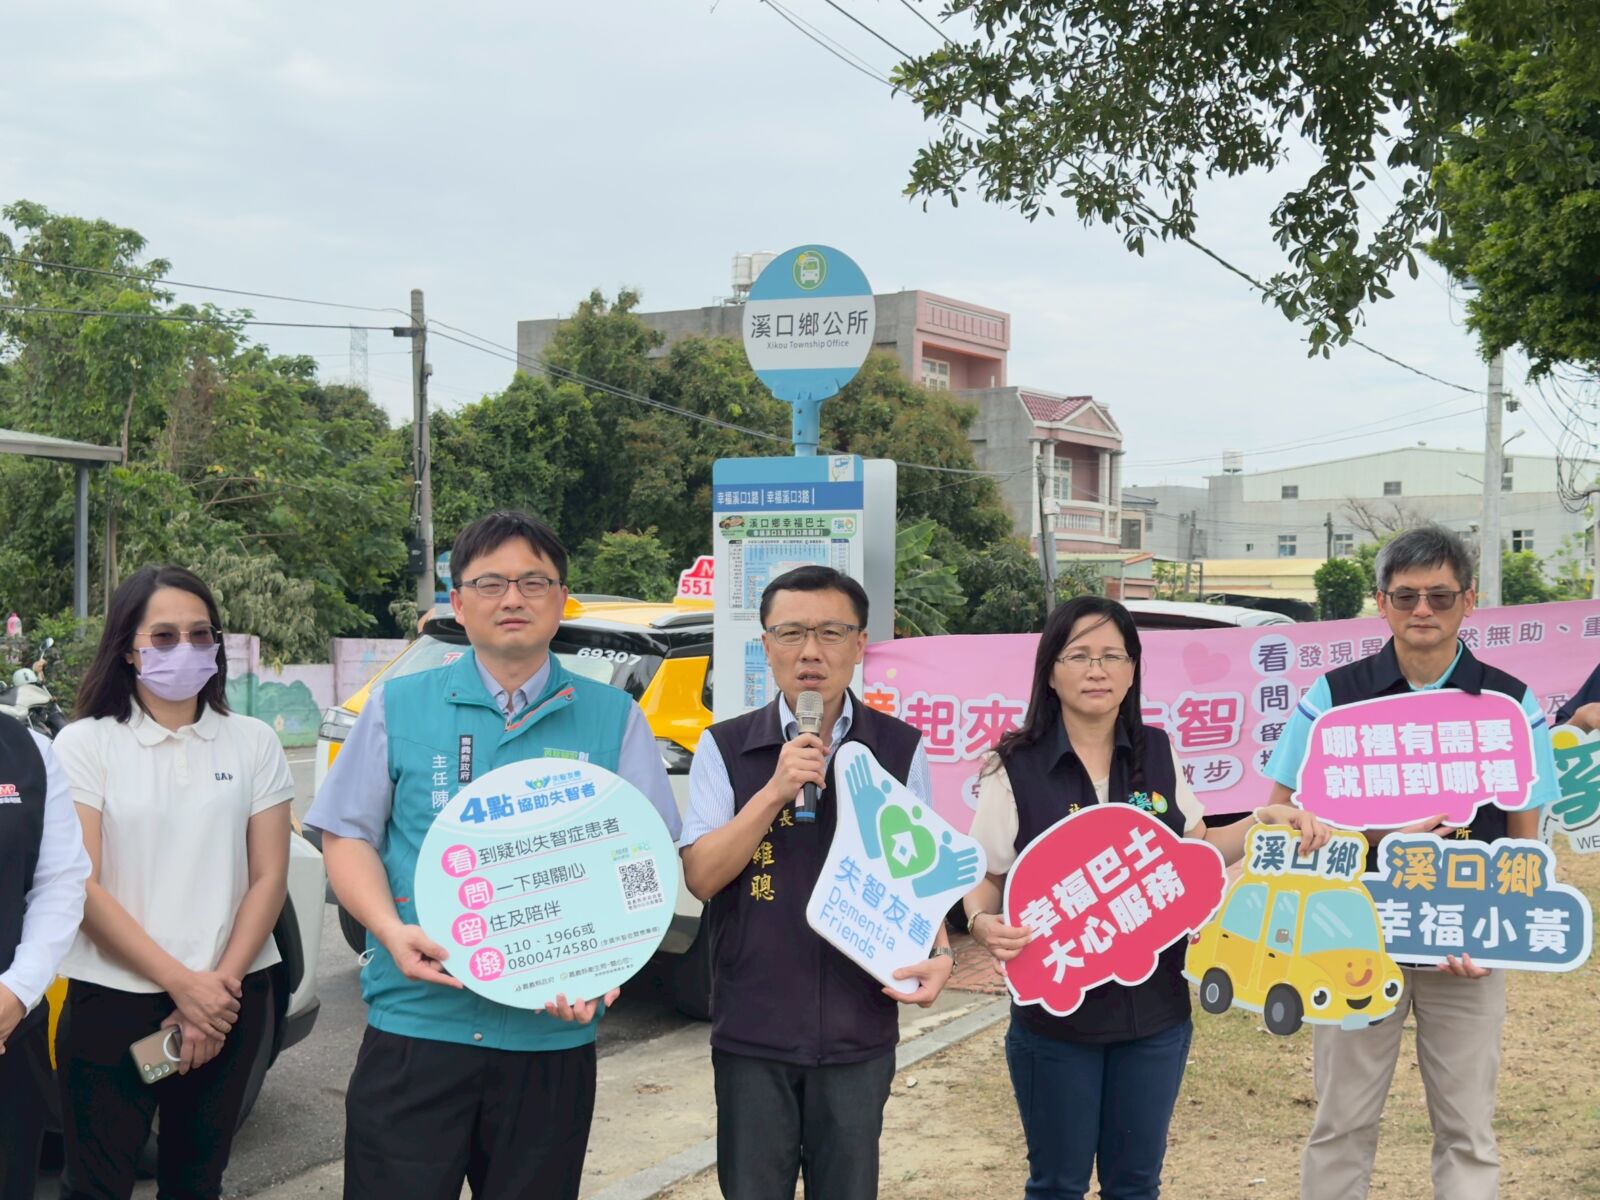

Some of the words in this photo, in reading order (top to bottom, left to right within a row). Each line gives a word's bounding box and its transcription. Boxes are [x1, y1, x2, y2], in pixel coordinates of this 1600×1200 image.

[751, 310, 868, 338] 溪口鄉公所
[790, 340, 825, 349] Township
[826, 339, 850, 348] Office
[749, 517, 826, 528] 溪口鄉幸福巴士
[681, 579, 713, 596] 551
[577, 647, 642, 666] 69307
[1258, 642, 1289, 673] 看
[1260, 685, 1289, 712] 問
[1321, 719, 1514, 758] 哪裡有需要
[1323, 759, 1520, 799] 就開到哪裡
[459, 794, 515, 824] 4點
[517, 782, 597, 814] 協助失智者
[779, 809, 794, 827] 長
[447, 848, 473, 874] 看
[479, 816, 621, 865] 到疑似失智症患者
[1252, 834, 1358, 878] 溪口鄉
[464, 880, 491, 908] 問
[496, 862, 587, 893] 一下與關心
[1018, 826, 1164, 940] 幸福巴士
[1391, 846, 1545, 897] 溪口鄉
[457, 917, 484, 944] 留
[489, 900, 562, 933] 住及陪伴
[828, 886, 896, 951] Dementia
[835, 856, 932, 949] 失智友善
[1042, 860, 1186, 985] 大心服務
[820, 903, 875, 960] Friends
[1375, 898, 1571, 954] 幸福小黃
[473, 950, 503, 977] 撥
[508, 938, 598, 970] 0800474580
